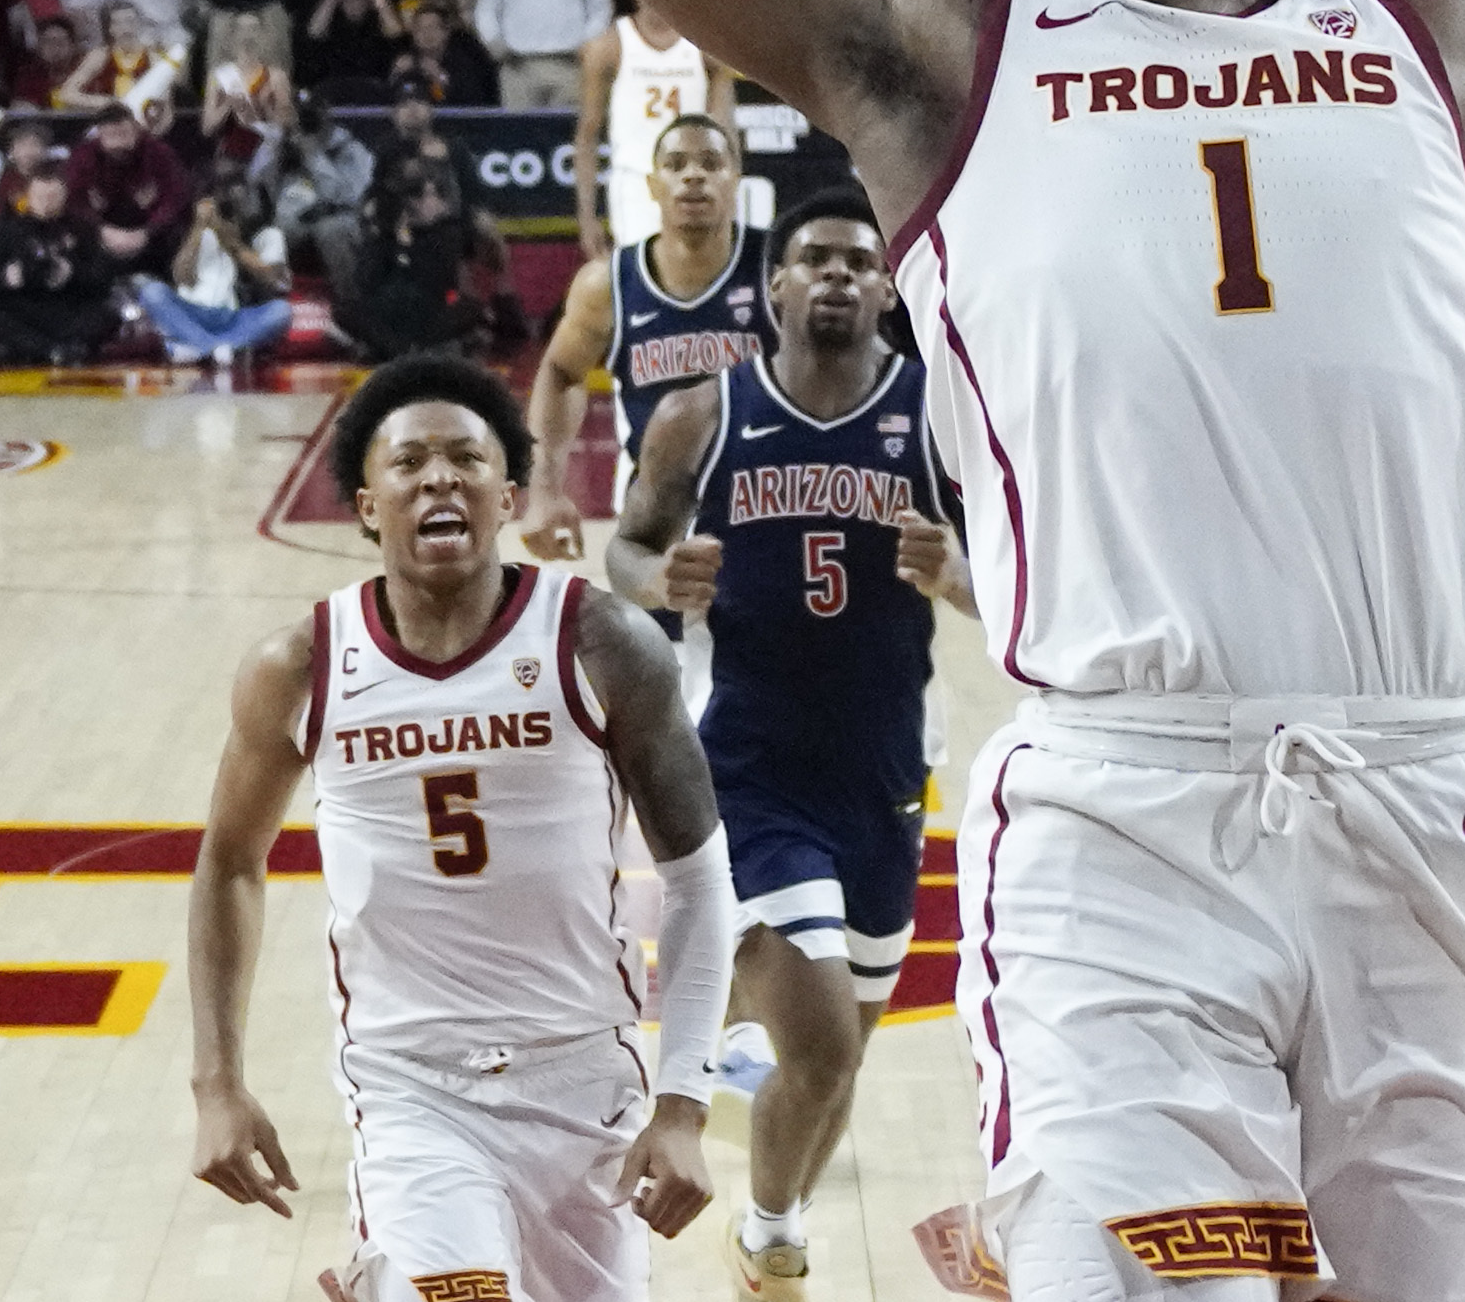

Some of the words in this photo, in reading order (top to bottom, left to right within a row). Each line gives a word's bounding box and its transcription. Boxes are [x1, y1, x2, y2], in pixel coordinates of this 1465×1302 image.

[645, 84, 682, 119] 24
[1035, 49, 1400, 124] TROJANS
[1199, 135, 1276, 317] 1
[730, 463, 914, 528] ARIZONA
[802, 530, 848, 617] 5
[342, 647, 360, 675] C
[334, 710, 553, 765] TROJANS
[421, 770, 489, 878] 5
